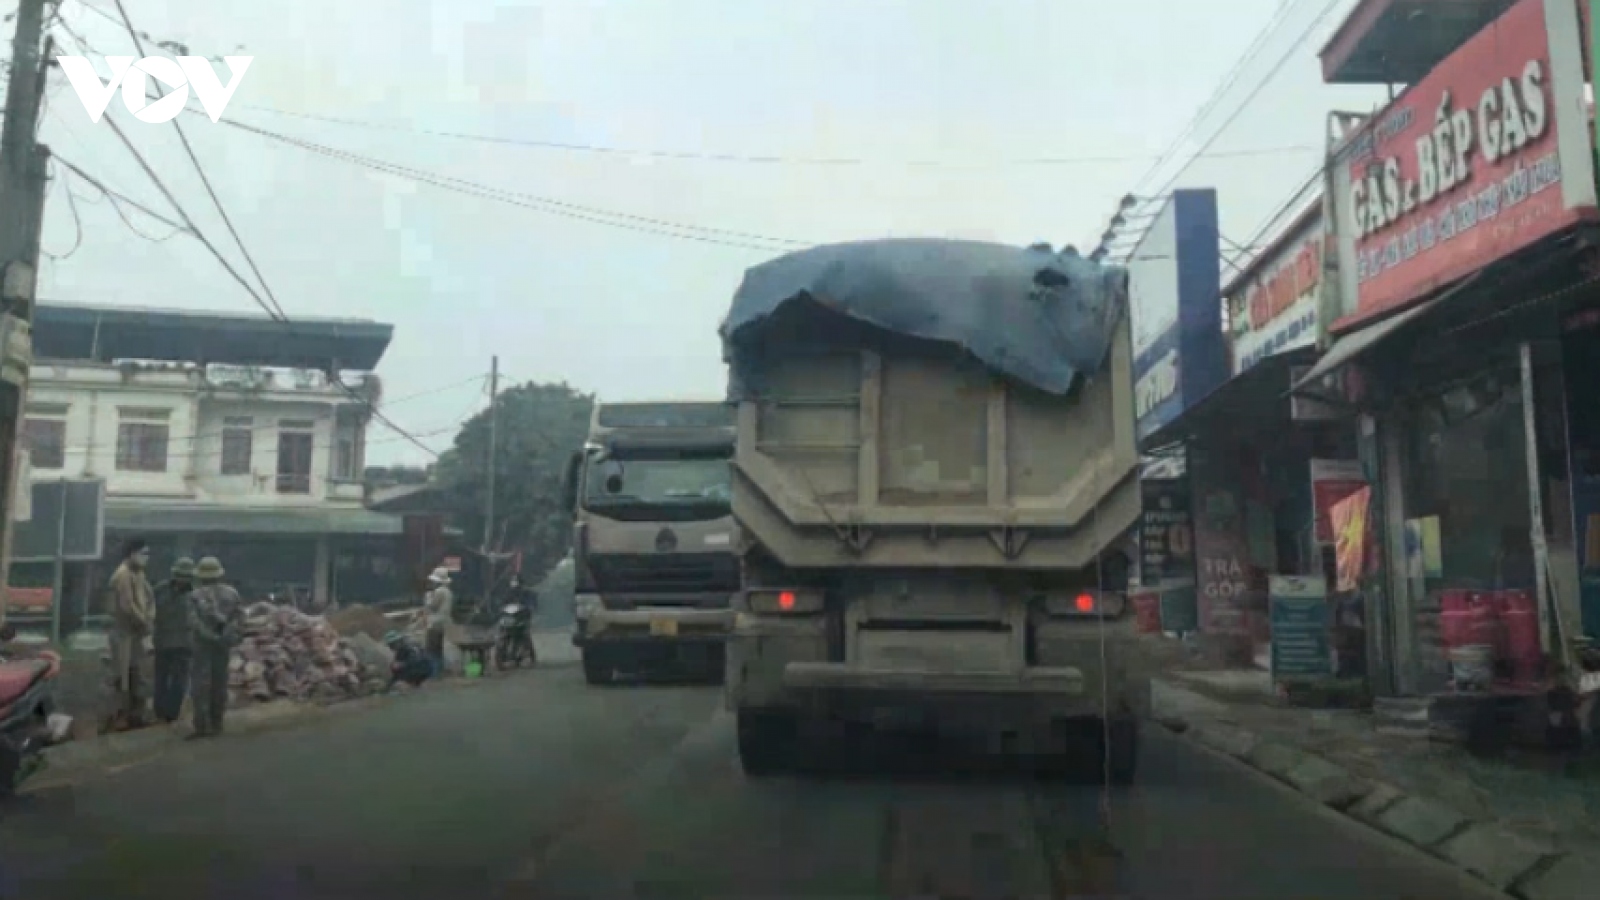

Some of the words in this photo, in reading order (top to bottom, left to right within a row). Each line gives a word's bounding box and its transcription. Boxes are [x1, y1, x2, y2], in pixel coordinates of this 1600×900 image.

[1350, 157, 1399, 240] GAS
[1416, 90, 1472, 203] BẾP
[1479, 60, 1545, 162] GAS
